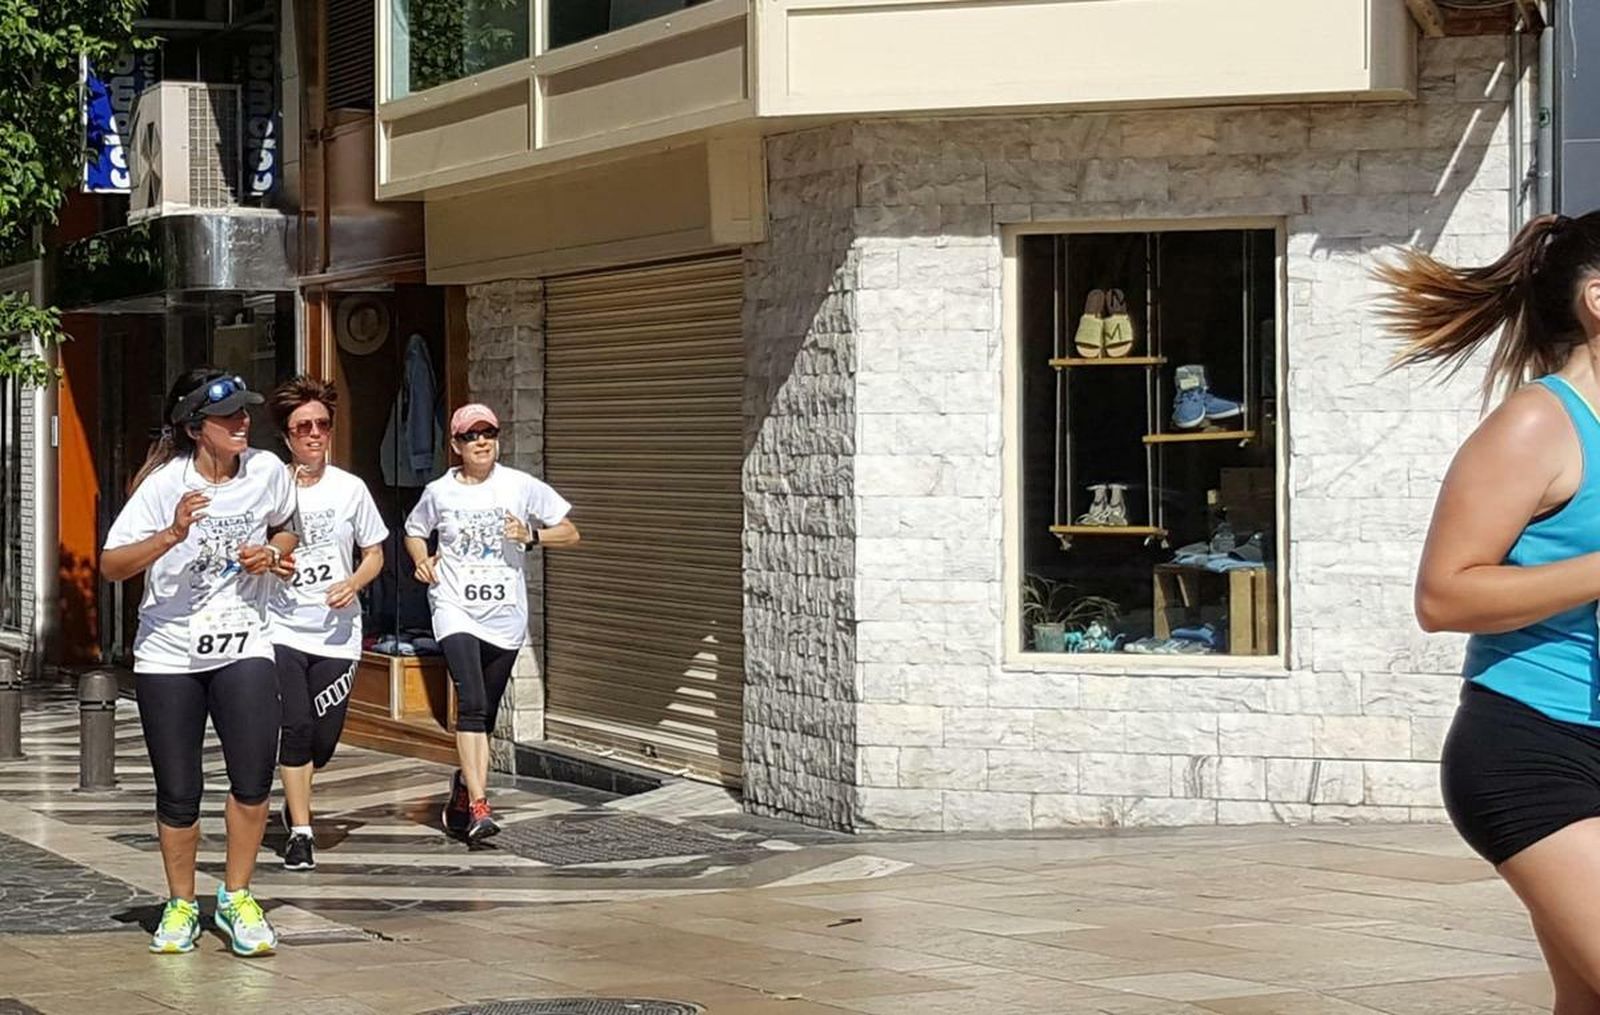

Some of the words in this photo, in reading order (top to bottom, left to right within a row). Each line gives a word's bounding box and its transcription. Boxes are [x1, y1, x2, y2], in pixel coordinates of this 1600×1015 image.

[292, 564, 333, 587] 232
[464, 583, 506, 601] 663
[196, 631, 249, 655] 877
[313, 660, 358, 717] PUM
